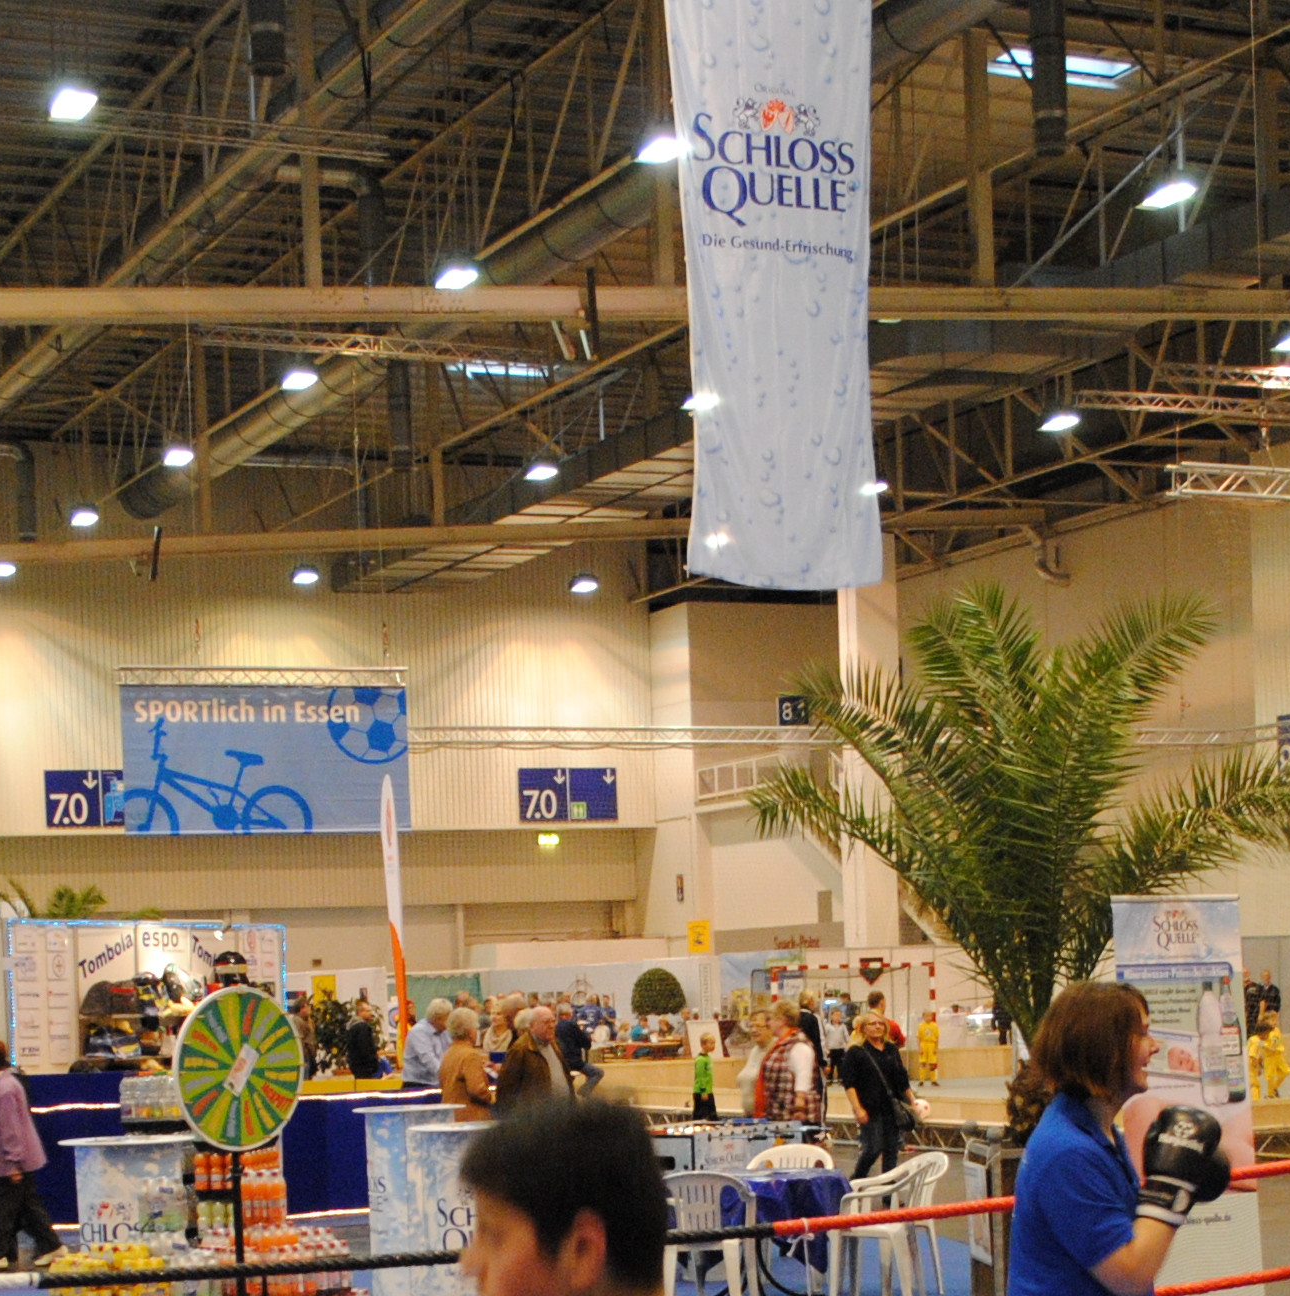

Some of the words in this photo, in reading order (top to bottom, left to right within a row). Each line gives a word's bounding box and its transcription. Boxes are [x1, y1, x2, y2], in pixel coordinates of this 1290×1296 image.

[692, 112, 855, 175] SCHLOSS
[702, 233, 726, 248] Die
[731, 235, 853, 264] Gesund-Erfrischung
[134, 698, 255, 723] SPORTlich
[264, 700, 287, 723] in
[295, 700, 360, 724] Essen
[49, 792, 89, 825] 7.0
[523, 788, 557, 819] 7.0
[78, 931, 134, 979] Tombola
[142, 929, 180, 952] espo
